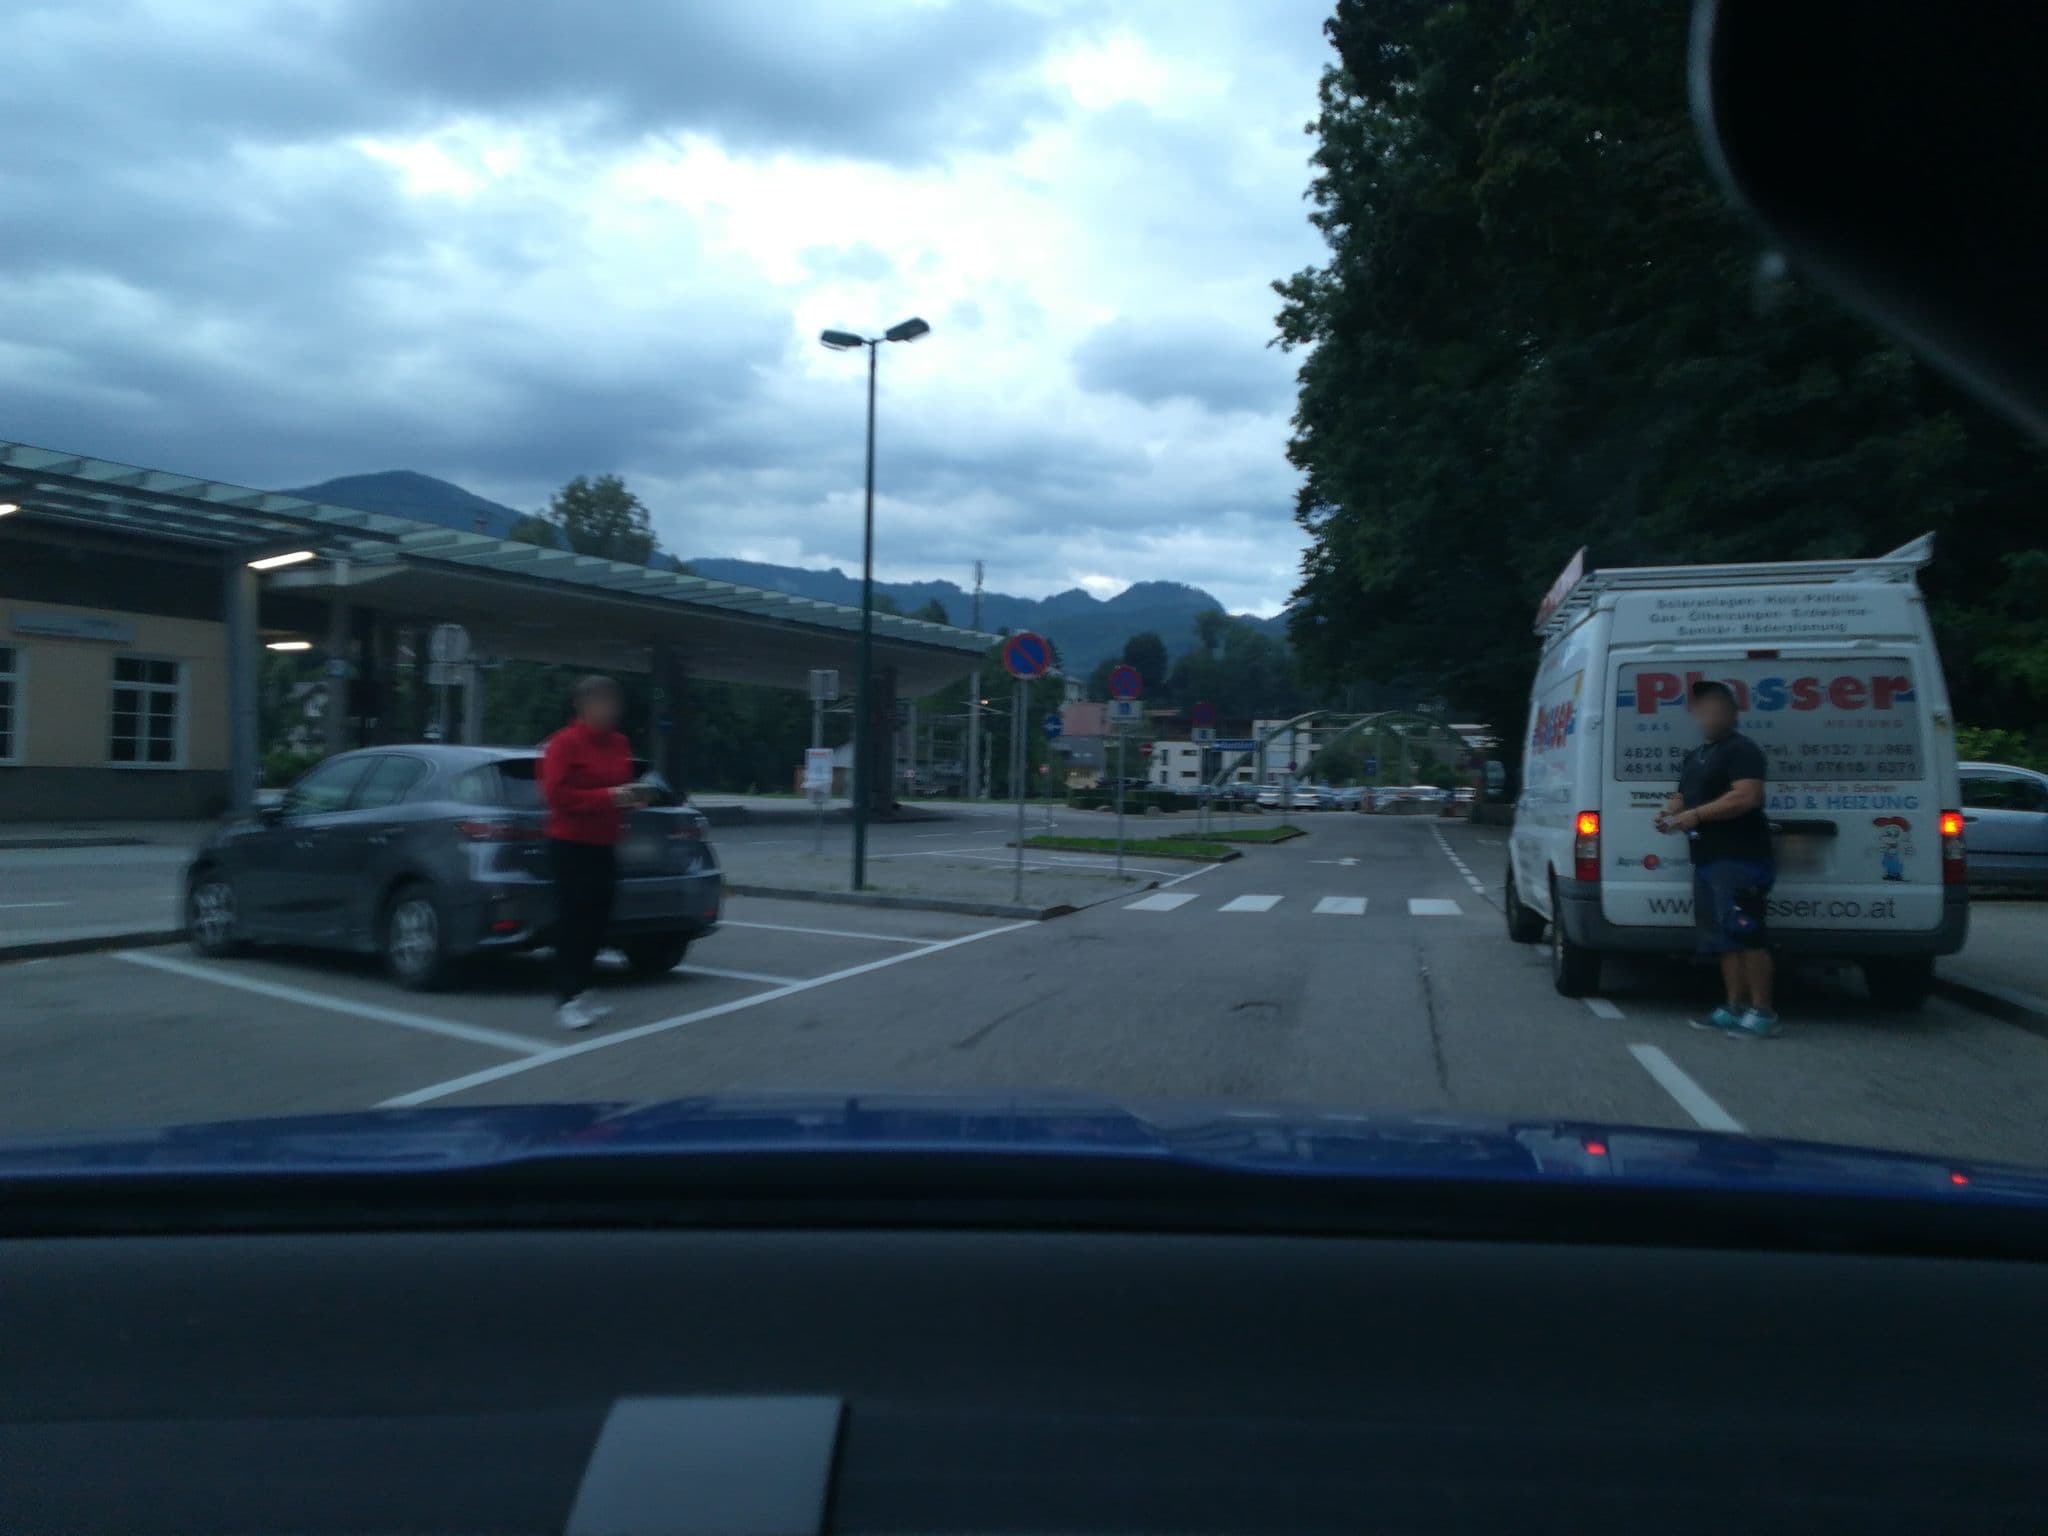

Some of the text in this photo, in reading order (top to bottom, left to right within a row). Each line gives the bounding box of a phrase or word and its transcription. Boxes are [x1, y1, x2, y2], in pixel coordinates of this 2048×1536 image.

[1623, 746, 1663, 759] 4820
[1769, 794, 1921, 810] AD & HEIZUNG
